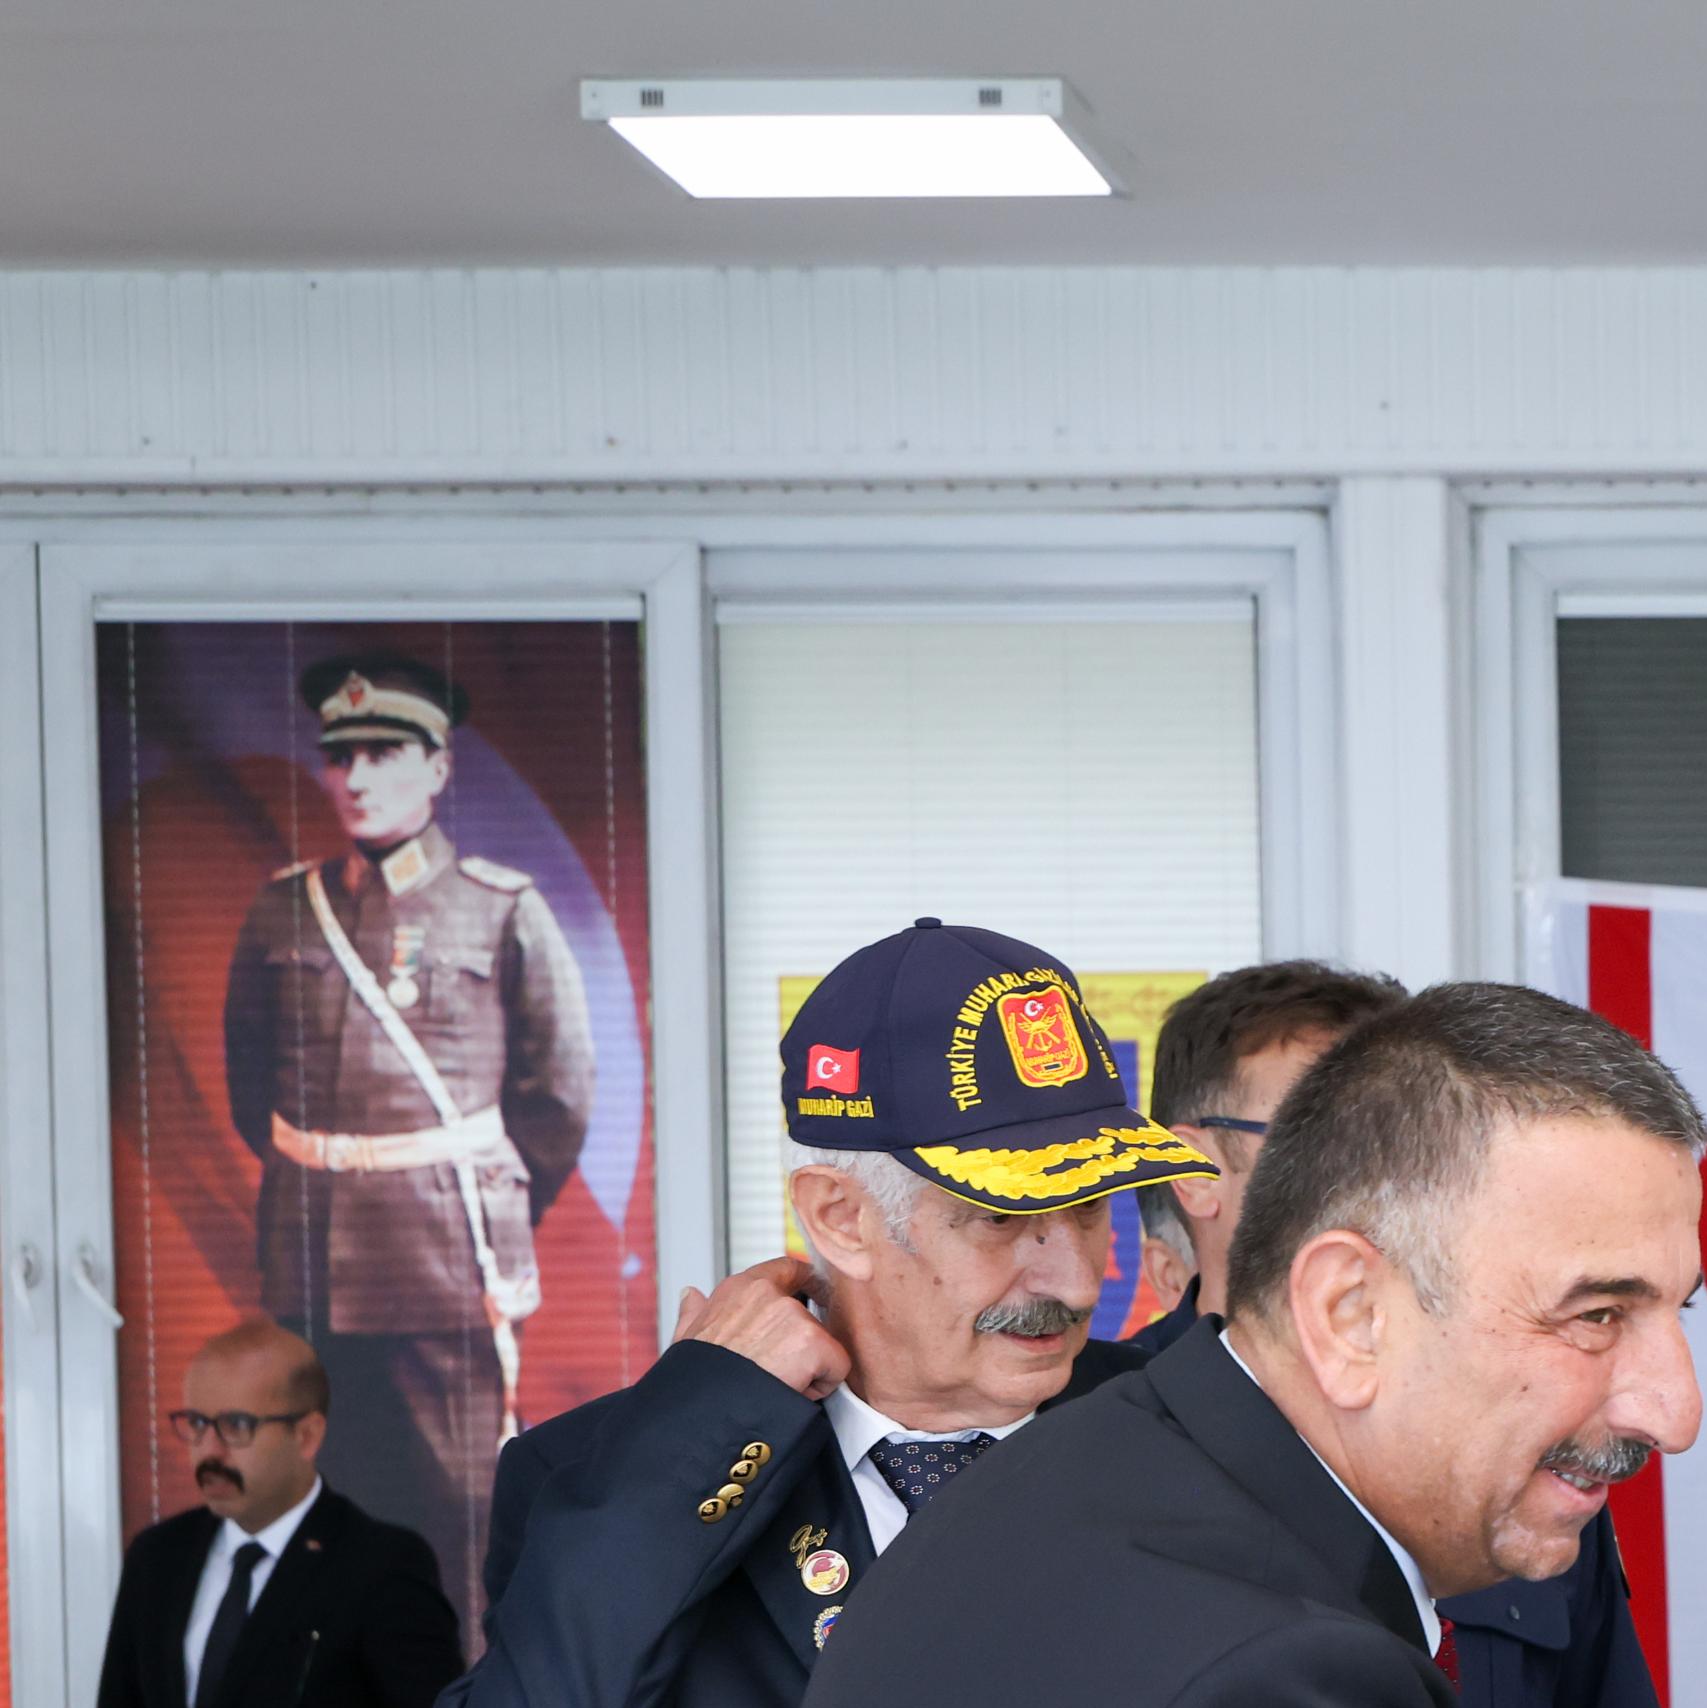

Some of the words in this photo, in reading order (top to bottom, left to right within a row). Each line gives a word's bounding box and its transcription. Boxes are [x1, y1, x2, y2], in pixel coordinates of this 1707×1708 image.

[946, 1026, 982, 1111] TÜRKİYE
[798, 1095, 846, 1117] MUHARİP
[846, 1096, 875, 1118] GAZİ
